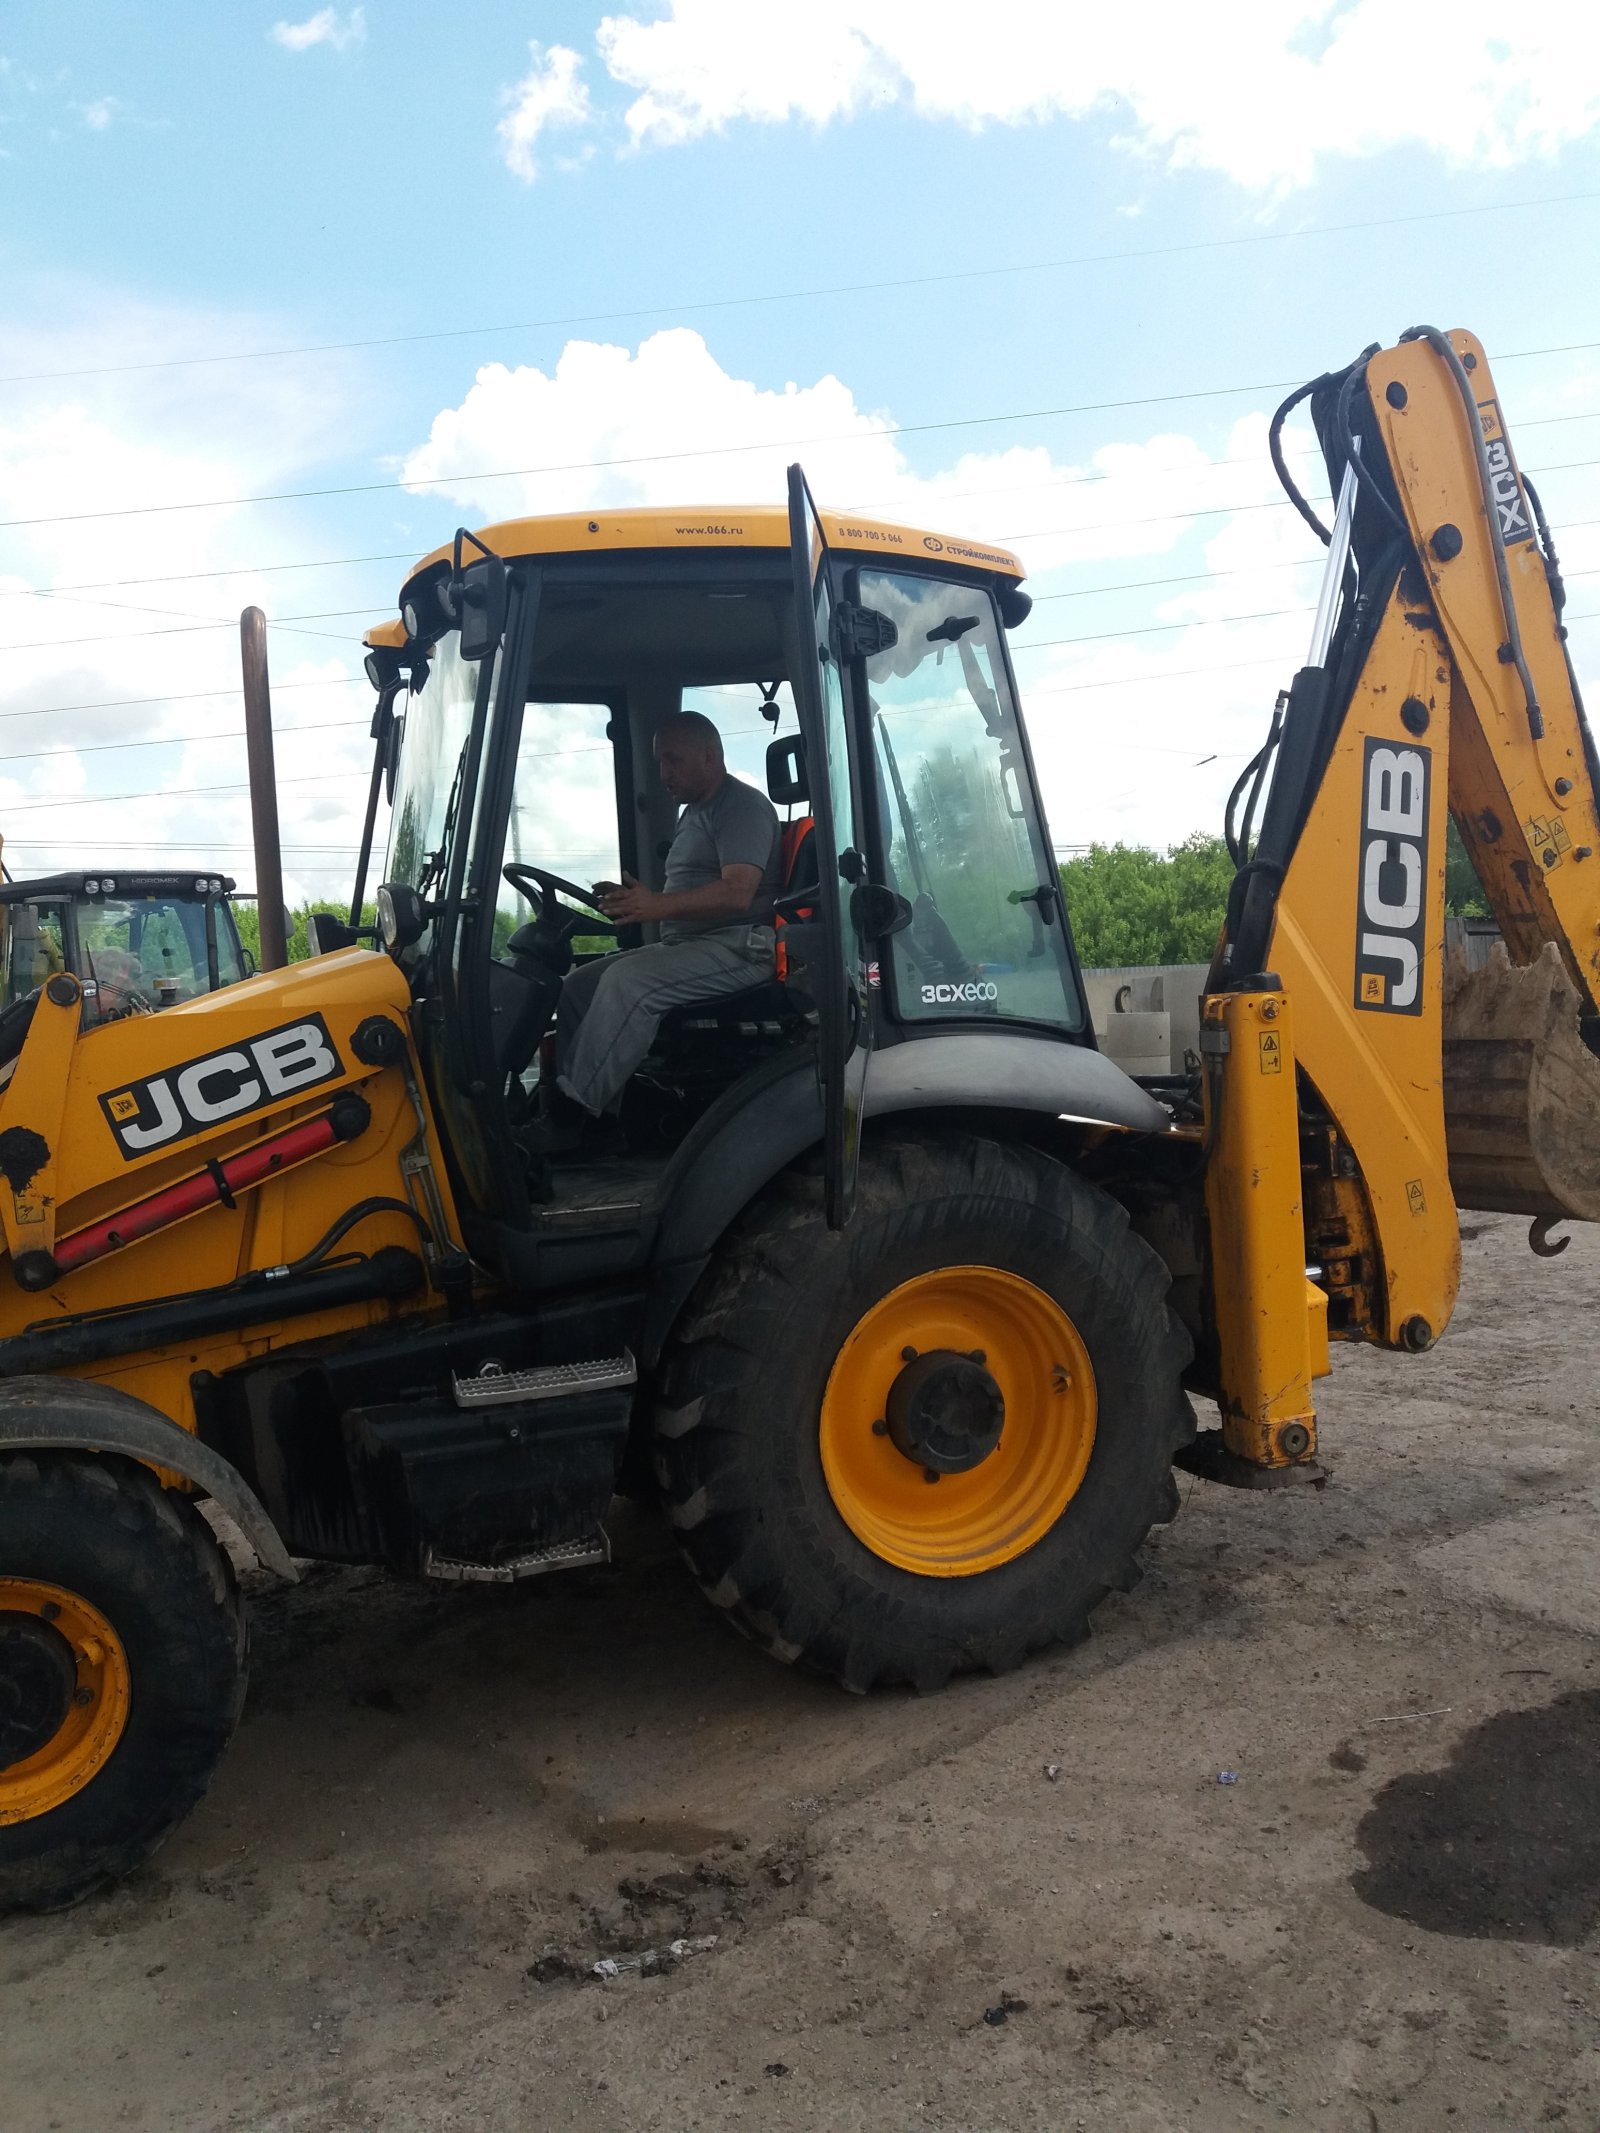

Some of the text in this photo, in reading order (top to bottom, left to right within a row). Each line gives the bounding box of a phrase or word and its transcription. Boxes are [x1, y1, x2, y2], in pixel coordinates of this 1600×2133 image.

[1486, 442, 1528, 533] 3CX
[675, 525, 743, 535] www.066.ru
[838, 527, 903, 544] 8 800 700 5 066
[946, 545, 1015, 567] СТРОЙКОМПЛЕКТ
[1362, 747, 1426, 1007] JCB
[1367, 978, 1378, 996] JCB
[120, 1024, 336, 1149] JCB
